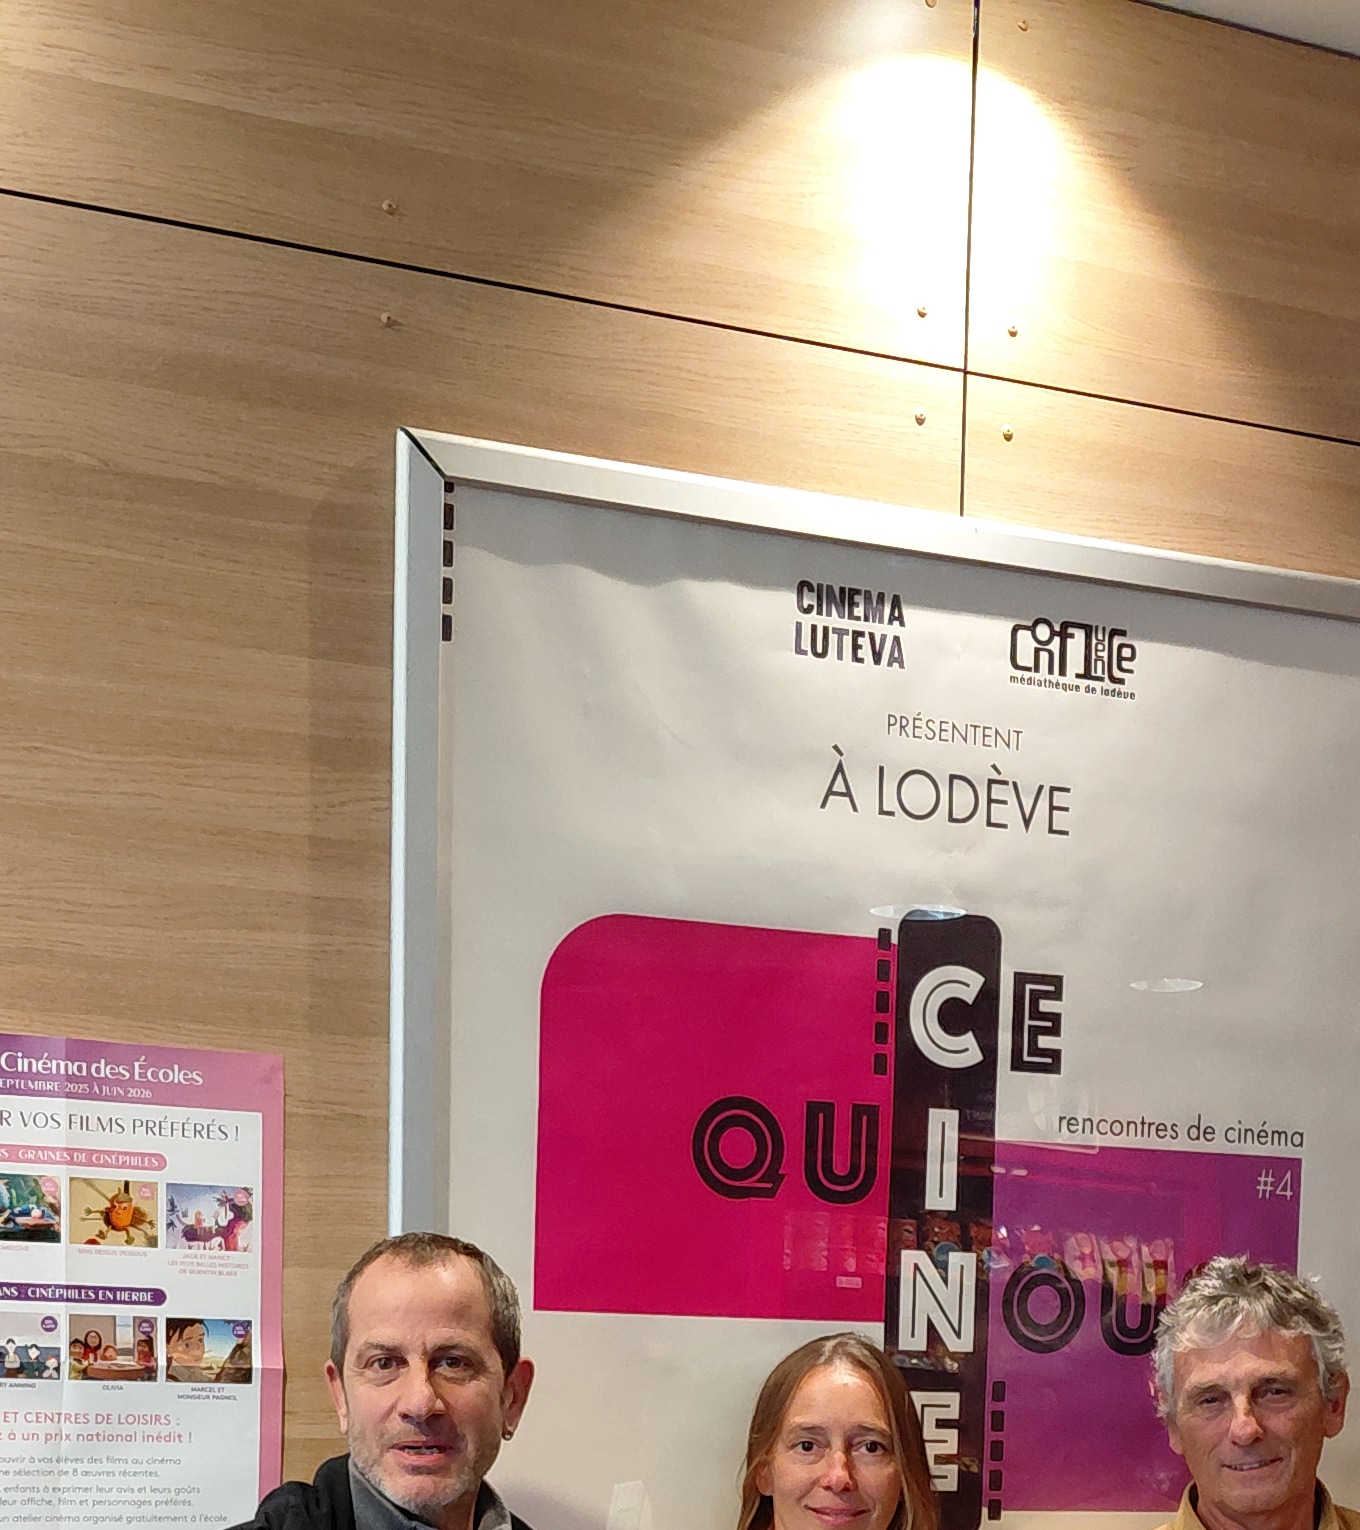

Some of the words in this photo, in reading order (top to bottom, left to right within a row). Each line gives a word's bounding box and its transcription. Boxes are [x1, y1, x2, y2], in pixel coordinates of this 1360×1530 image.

[796, 579, 906, 628] CINEMA
[794, 621, 906, 669] LUTEVA
[1009, 674, 1081, 693] médiathèque
[1084, 684, 1097, 695] de
[887, 712, 1023, 751] PRÉSENTENT
[819, 744, 859, 813] À
[877, 763, 1071, 836] LODÈVE
[0, 1051, 87, 1077] Cinéma
[90, 1058, 131, 1081] des
[133, 1055, 204, 1086] Écoles
[64, 1082, 90, 1094] 2025
[92, 1082, 100, 1095] À
[101, 1085, 125, 1097] JUIN
[127, 1087, 153, 1099] 2026
[19, 1110, 62, 1129] VOS
[68, 1113, 125, 1134] FILMS
[132, 1114, 229, 1141] PRÉFÉRÉS
[1058, 1114, 1179, 1141] rencontres
[1187, 1113, 1216, 1143] de
[1224, 1119, 1305, 1148] cinéma
[18, 1149, 70, 1162] GRAINES
[74, 1152, 88, 1163] DE
[1256, 1168, 1294, 1201] #4
[27, 1285, 95, 1300] CINÉPHILES
[99, 1289, 113, 1301] EN
[116, 1290, 154, 1303] HERBE
[3, 1411, 19, 1423] ET
[24, 1411, 90, 1425] CENTRES
[95, 1413, 113, 1425] DE
[118, 1413, 171, 1426] LOISIRS
[7, 1429, 16, 1441] à
[22, 1432, 40, 1441] un
[44, 1429, 71, 1445] prix
[76, 1430, 137, 1442] national
[142, 1430, 183, 1443] inédit
[29, 1454, 35, 1464] à
[37, 1456, 53, 1464] vos
[55, 1455, 84, 1465] élèves
[87, 1455, 103, 1465] des
[106, 1455, 129, 1465] films
[131, 1457, 143, 1466] au
[146, 1456, 181, 1466] cinéma
[13, 1468, 55, 1478] sélection
[57, 1468, 70, 1478] de
[72, 1469, 78, 1478] 8
[3, 1484, 40, 1494] enfants
[51, 1485, 93, 1496] exprimer
[96, 1485, 114, 1494] leur
[116, 1485, 135, 1494] avis
[137, 1485, 147, 1494] et
[150, 1485, 171, 1494] leurs
[174, 1484, 201, 1496] goûts
[0, 1497, 17, 1506] leur
[58, 1497, 76, 1506] film
[79, 1497, 88, 1506] et
[91, 1498, 152, 1508] personnages
[12, 1514, 41, 1523] atelier
[45, 1514, 80, 1523] cinéma
[82, 1513, 123, 1525] organisé
[126, 1513, 188, 1525] gratuitement
[190, 1513, 197, 1523] à
